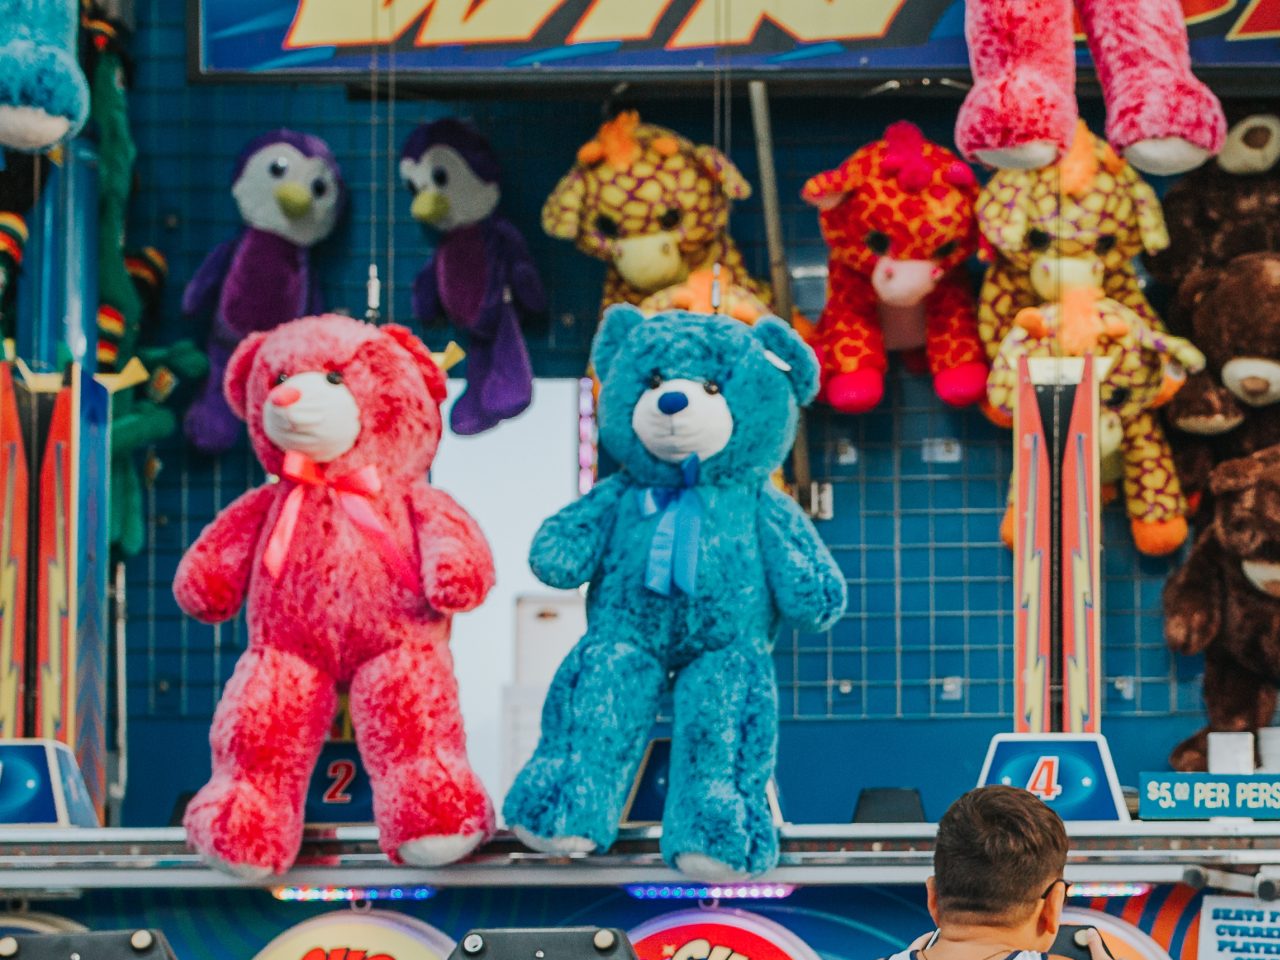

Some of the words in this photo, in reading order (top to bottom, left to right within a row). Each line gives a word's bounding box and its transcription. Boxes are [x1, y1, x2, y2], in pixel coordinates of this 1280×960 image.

[324, 760, 356, 803] 2
[1026, 755, 1062, 800] 4
[1194, 782, 1230, 808] PER
[1212, 908, 1265, 922] SEATS
